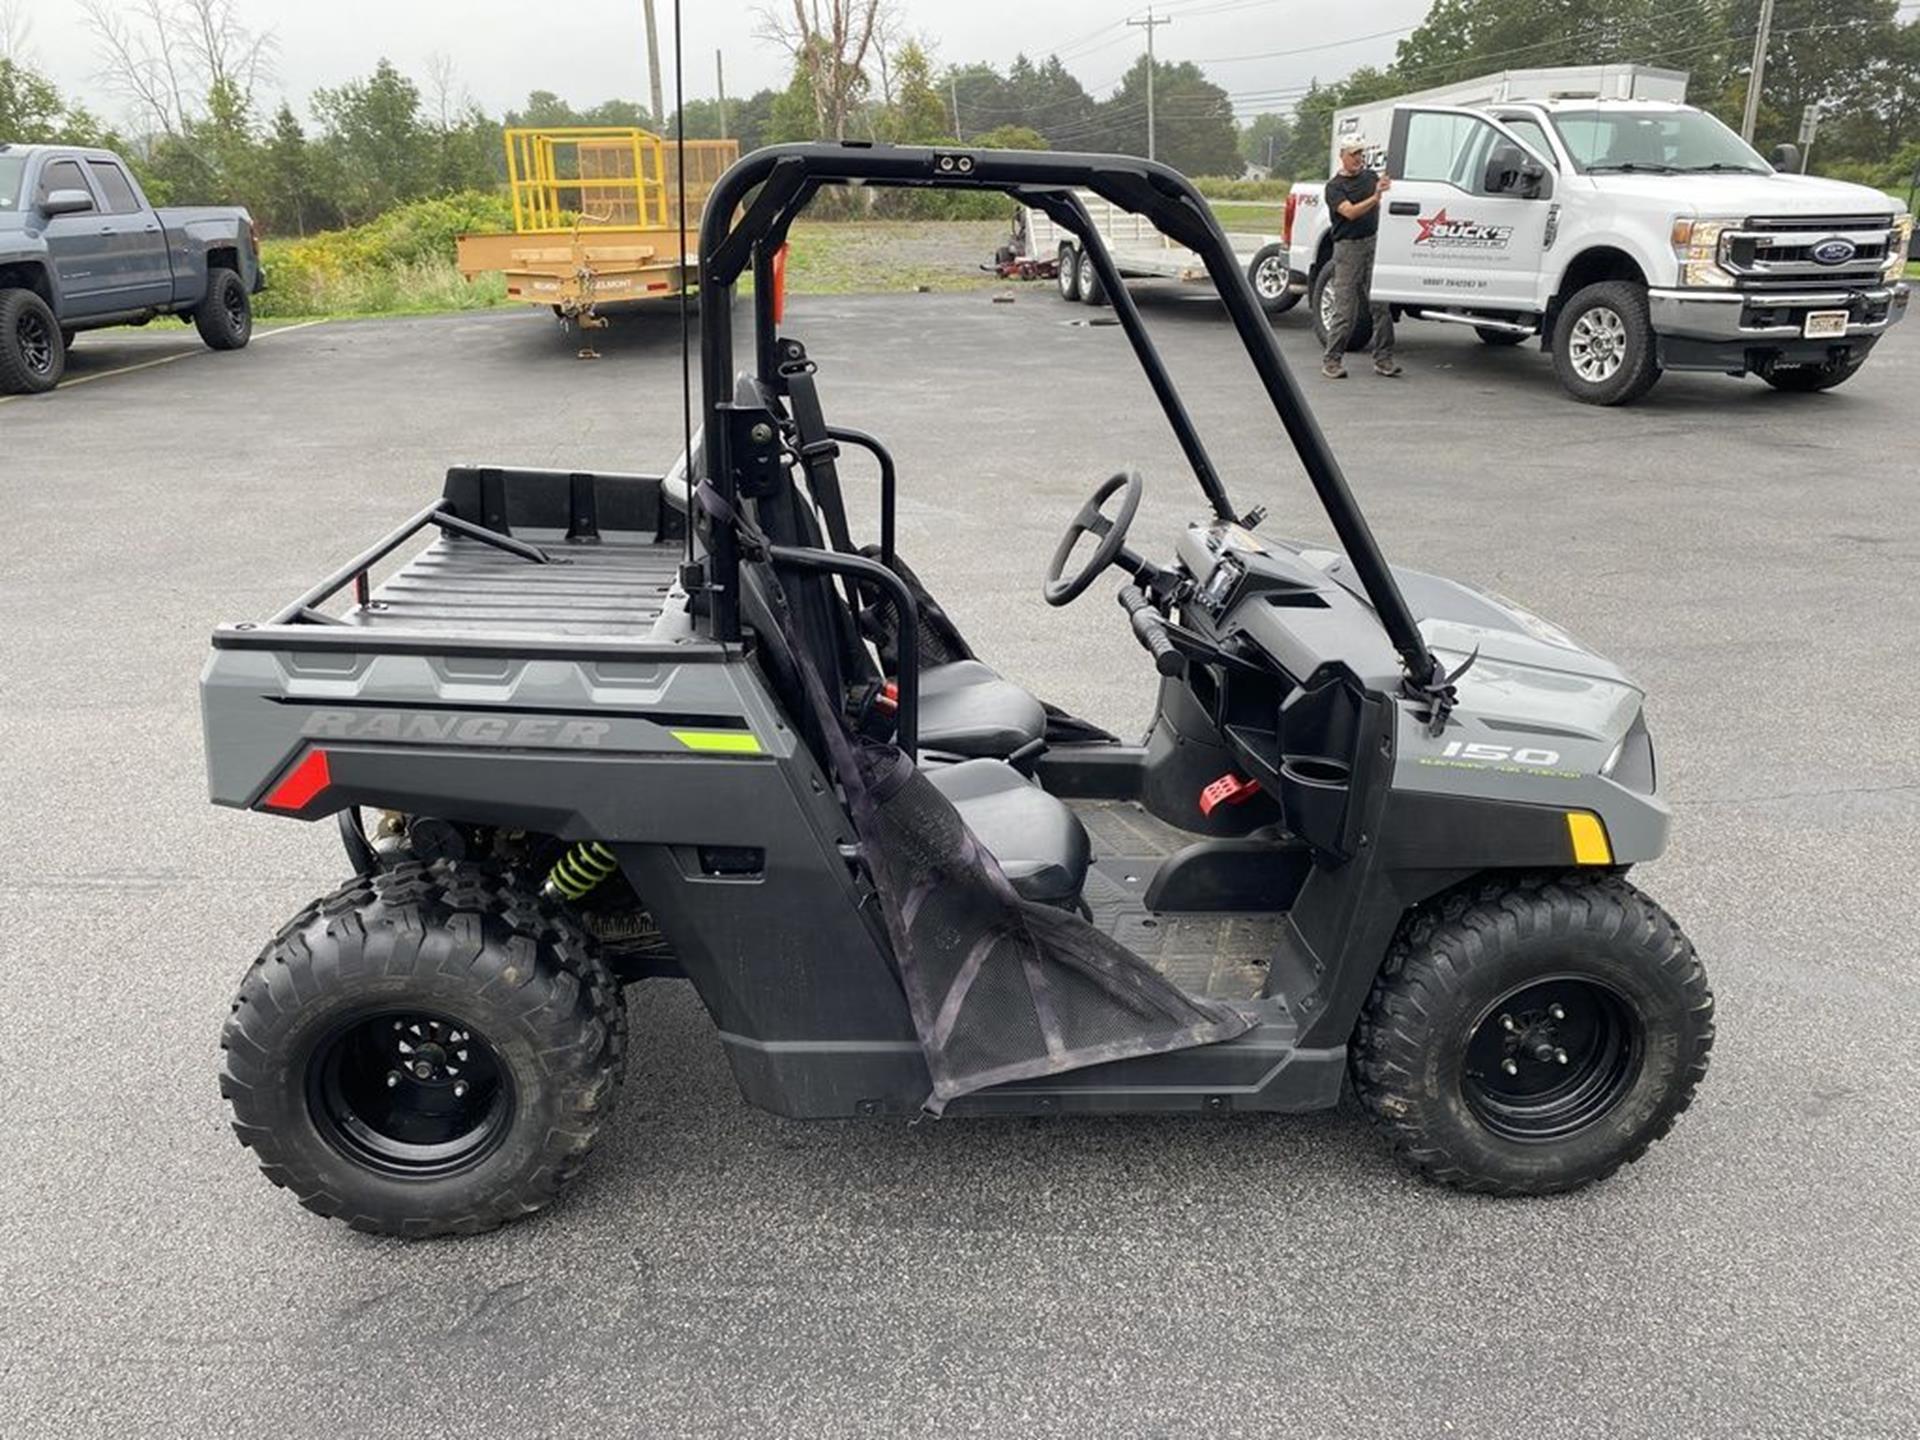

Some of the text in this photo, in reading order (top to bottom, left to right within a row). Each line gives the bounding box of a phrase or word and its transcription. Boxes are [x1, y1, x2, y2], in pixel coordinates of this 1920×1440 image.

[1428, 223, 1515, 240] BUCK'S
[300, 710, 611, 745] RANGER
[1441, 741, 1561, 766] 150
